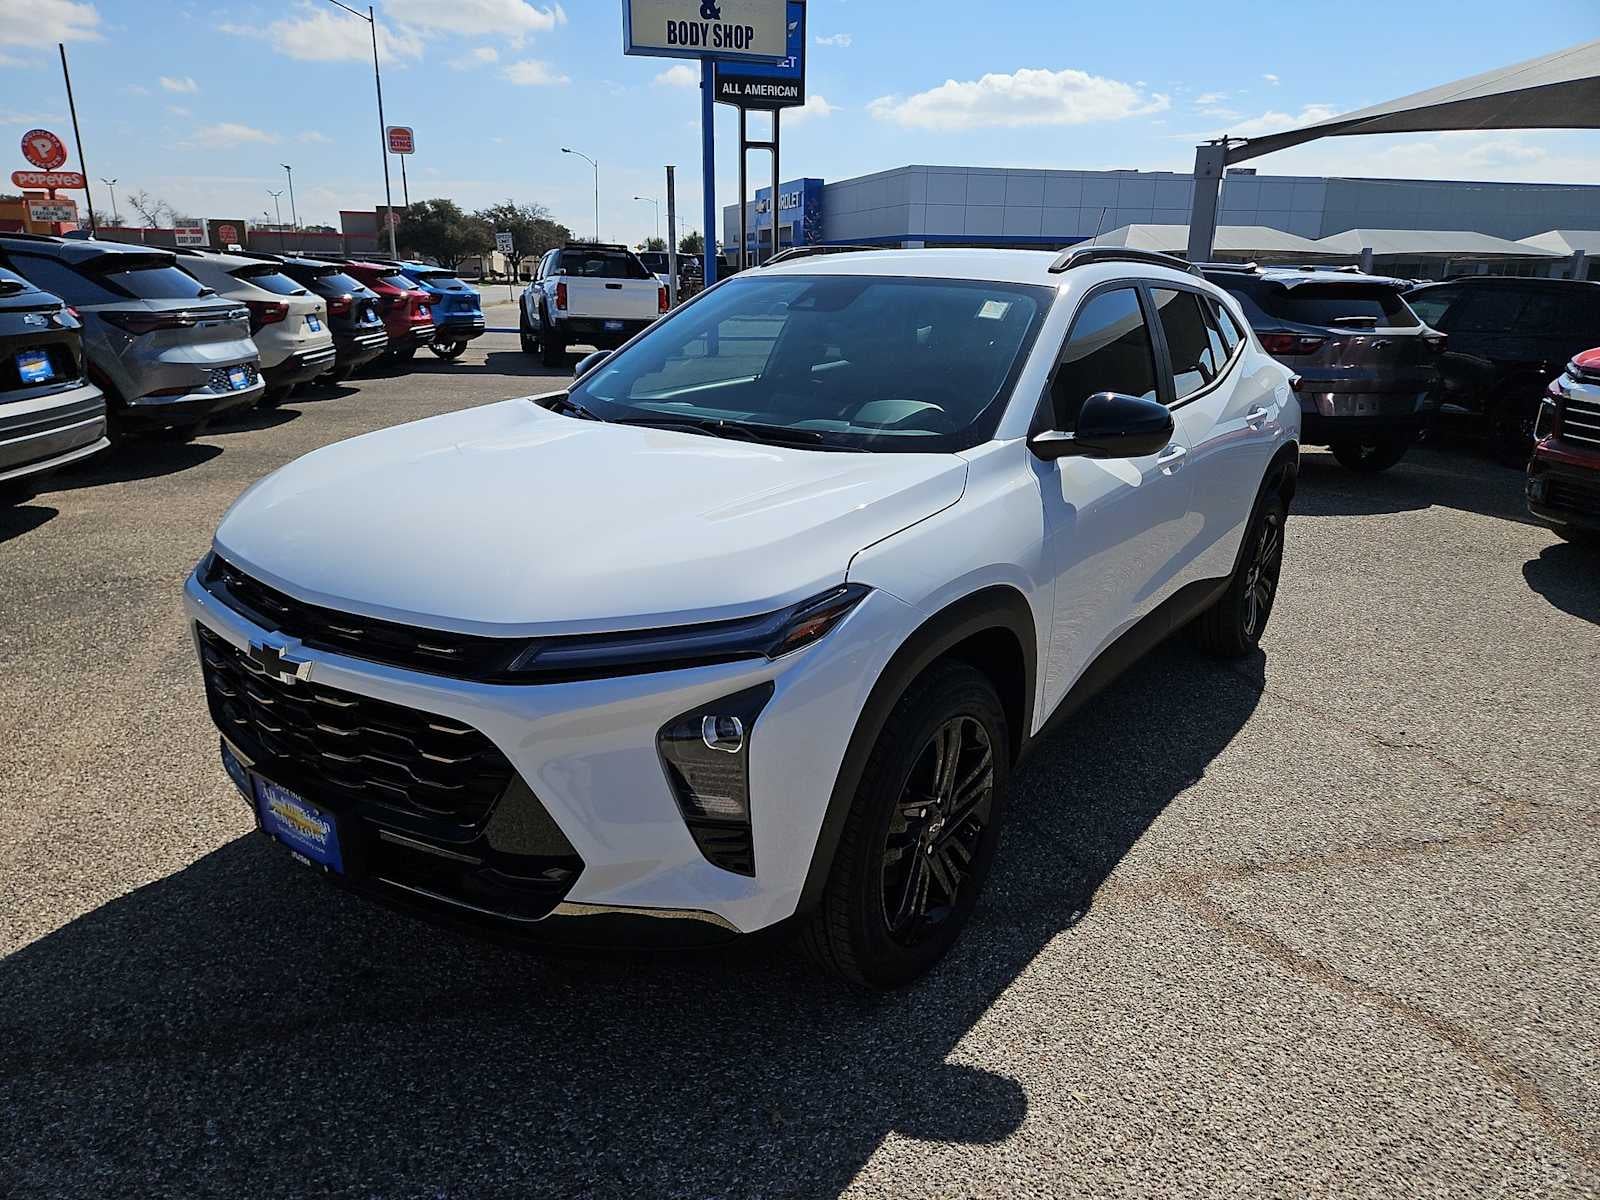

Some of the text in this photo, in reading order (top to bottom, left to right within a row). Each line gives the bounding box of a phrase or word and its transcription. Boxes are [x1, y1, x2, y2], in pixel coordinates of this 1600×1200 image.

[667, 20, 754, 50] BODY SHOP
[722, 82, 798, 98] ALL AMERICAN
